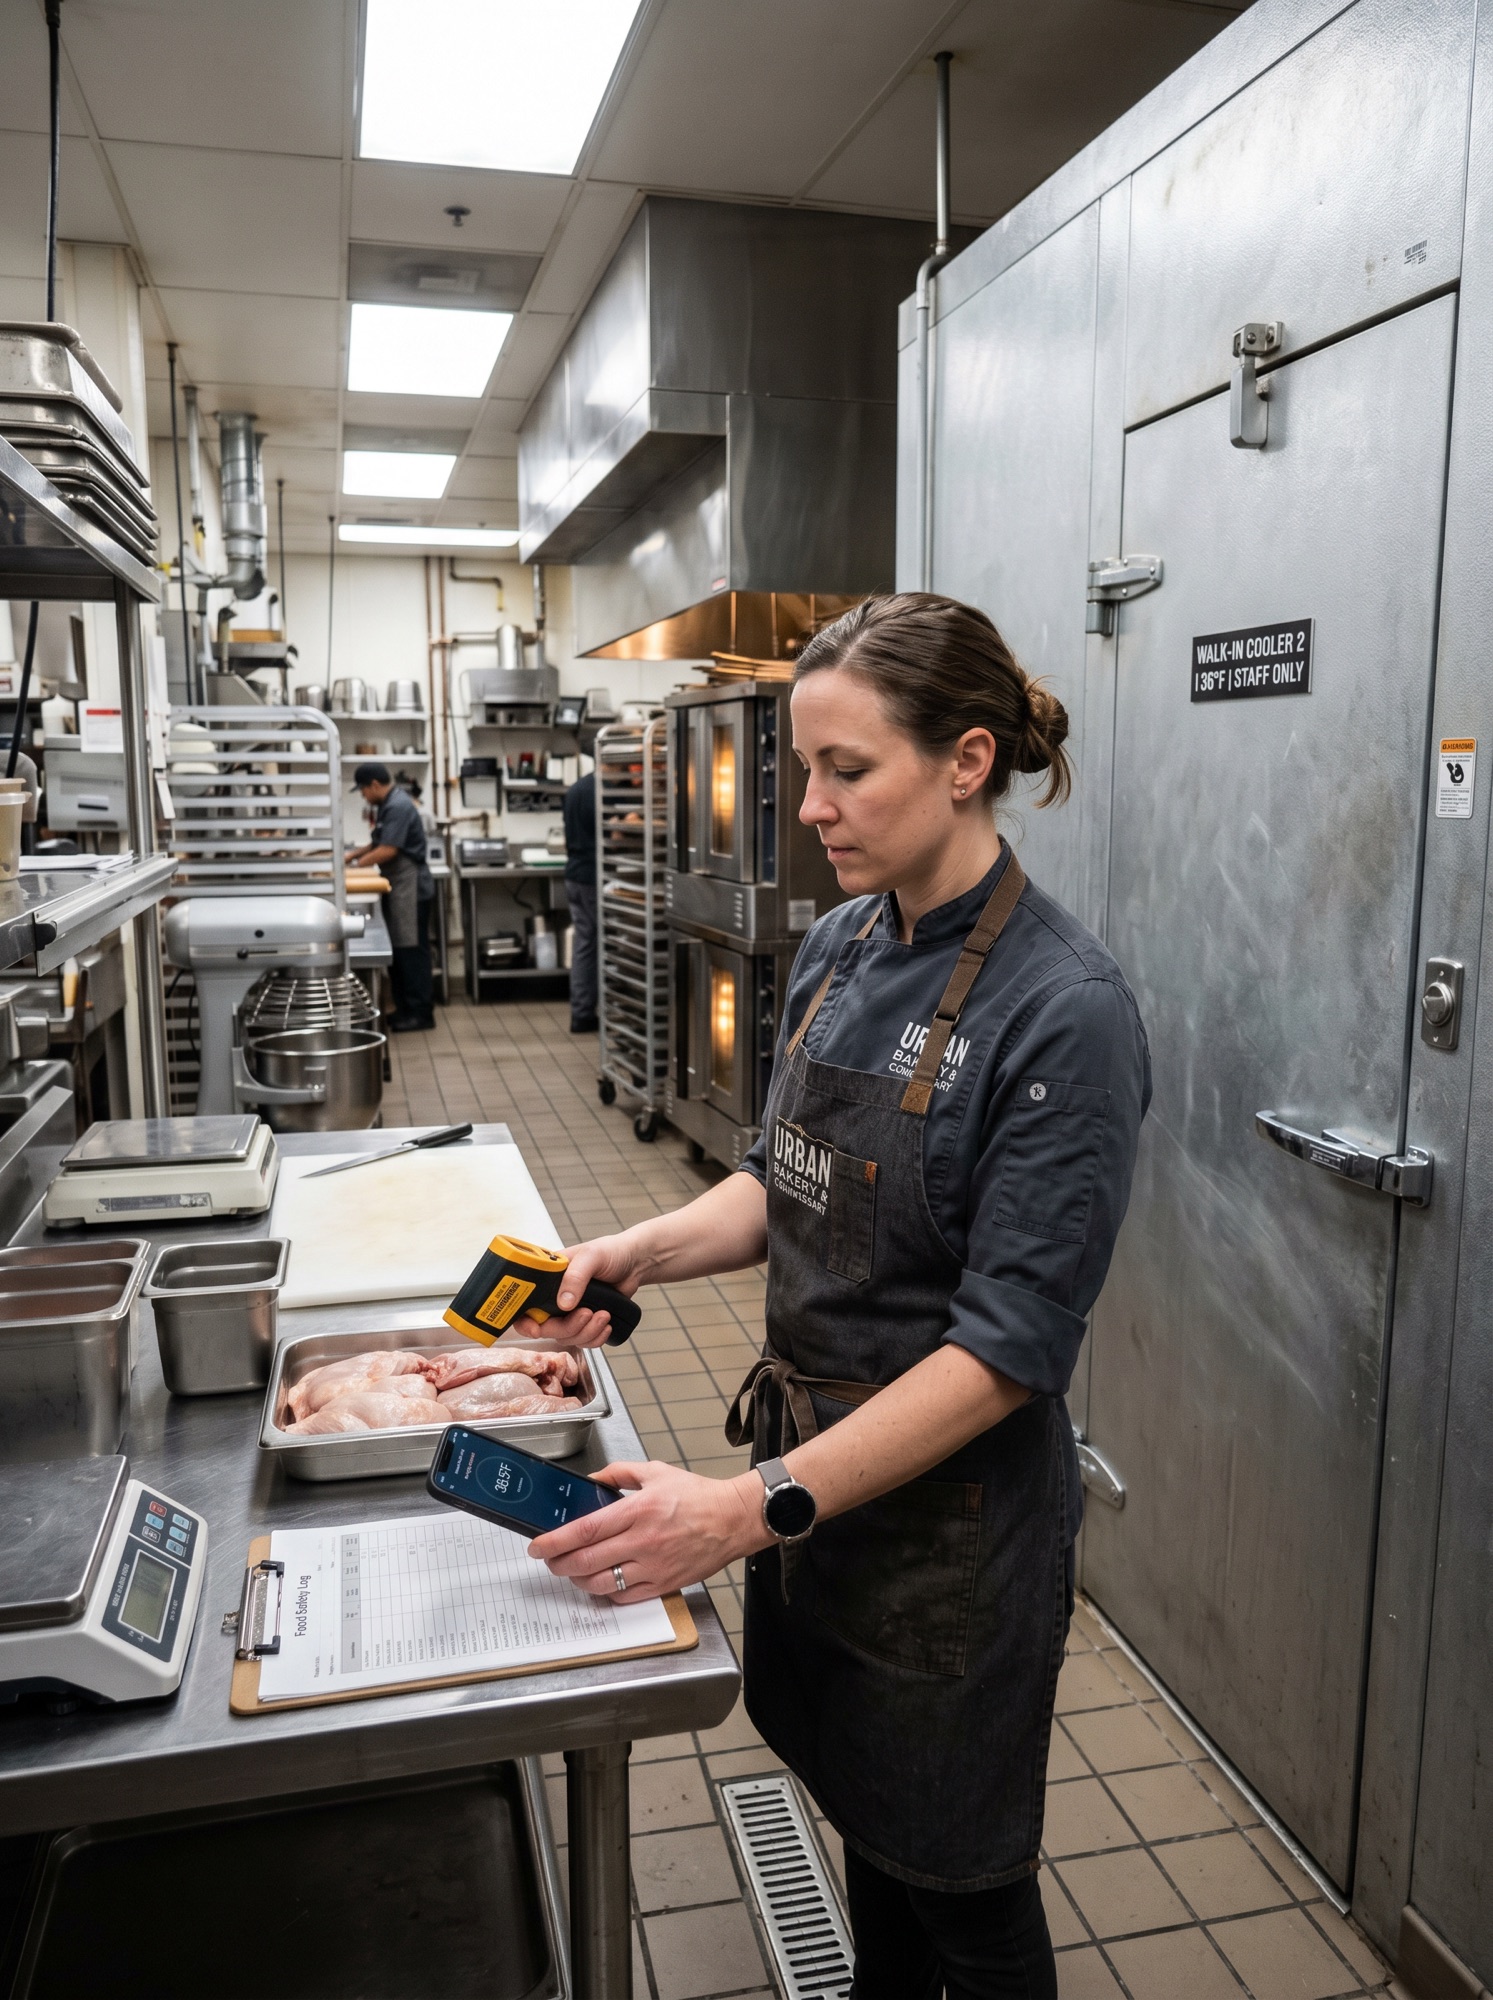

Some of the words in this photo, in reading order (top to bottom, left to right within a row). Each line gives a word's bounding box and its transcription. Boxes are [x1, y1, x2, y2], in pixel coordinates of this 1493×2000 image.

[1197, 640, 1243, 664] WALK-IN
[1246, 632, 1293, 658] COOLER
[1296, 631, 1305, 652] 2
[1200, 670, 1226, 691] 36°F
[1234, 665, 1270, 688] STAFF
[1272, 661, 1305, 684] ONLY
[900, 1021, 971, 1067] URAN
[774, 1124, 832, 1188] URBAN
[774, 1161, 817, 1196] BAKERY
[820, 1190, 828, 1204] &
[297, 1575, 312, 1590] Log
[295, 1591, 311, 1614] Safety
[294, 1616, 307, 1637] Food
